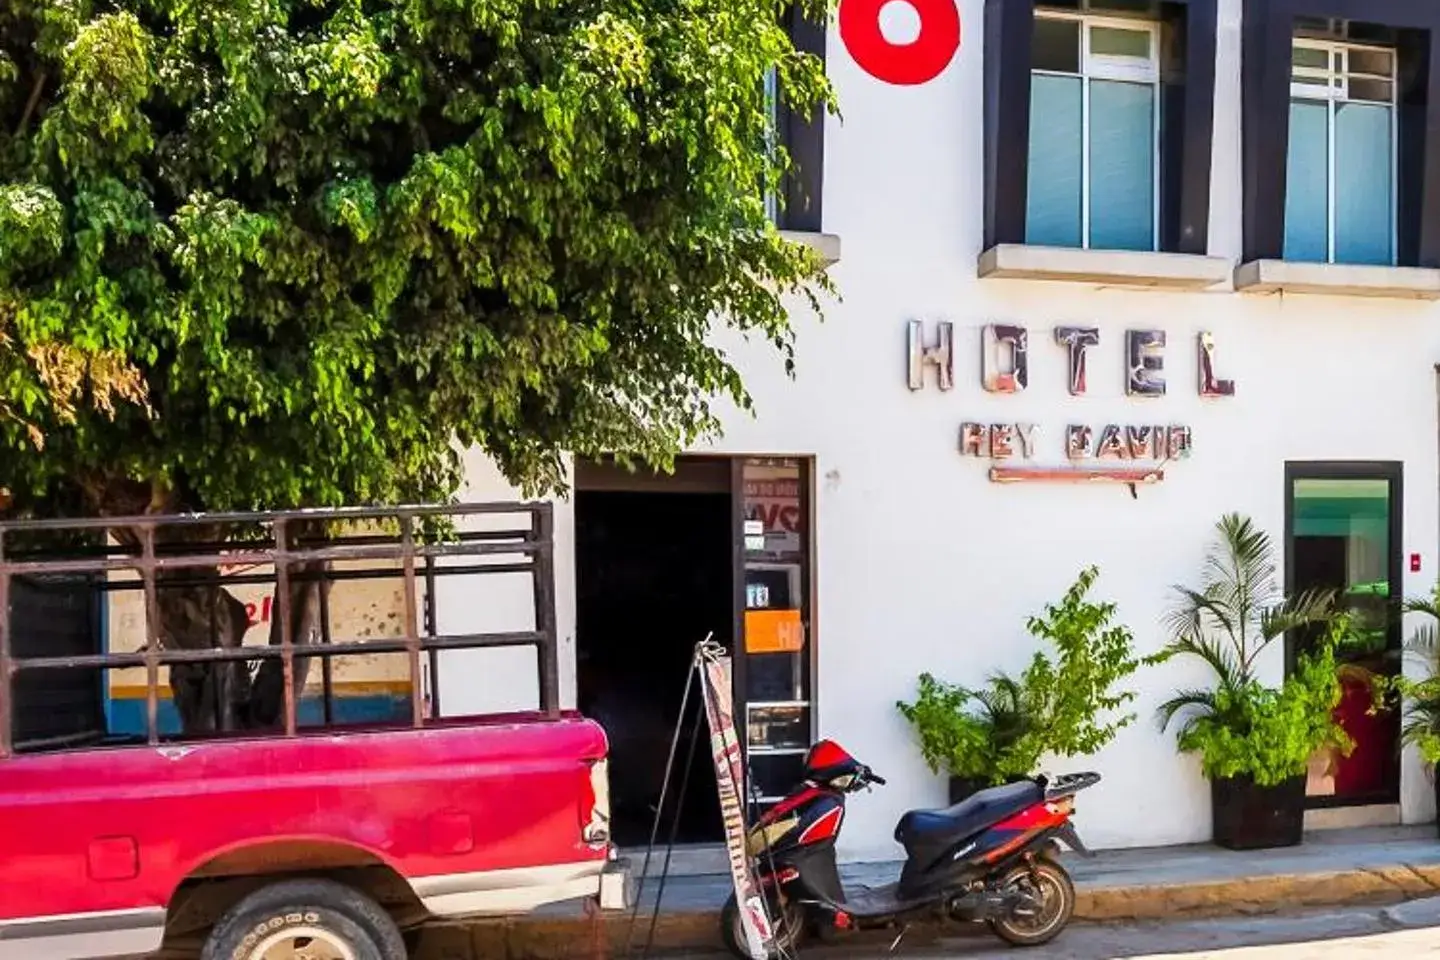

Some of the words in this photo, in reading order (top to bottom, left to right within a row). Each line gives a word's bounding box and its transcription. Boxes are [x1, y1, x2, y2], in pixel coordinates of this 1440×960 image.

[907, 320, 1235, 397] HOTEL
[959, 422, 1045, 459] REY
[1066, 423, 1191, 460] DAVID
